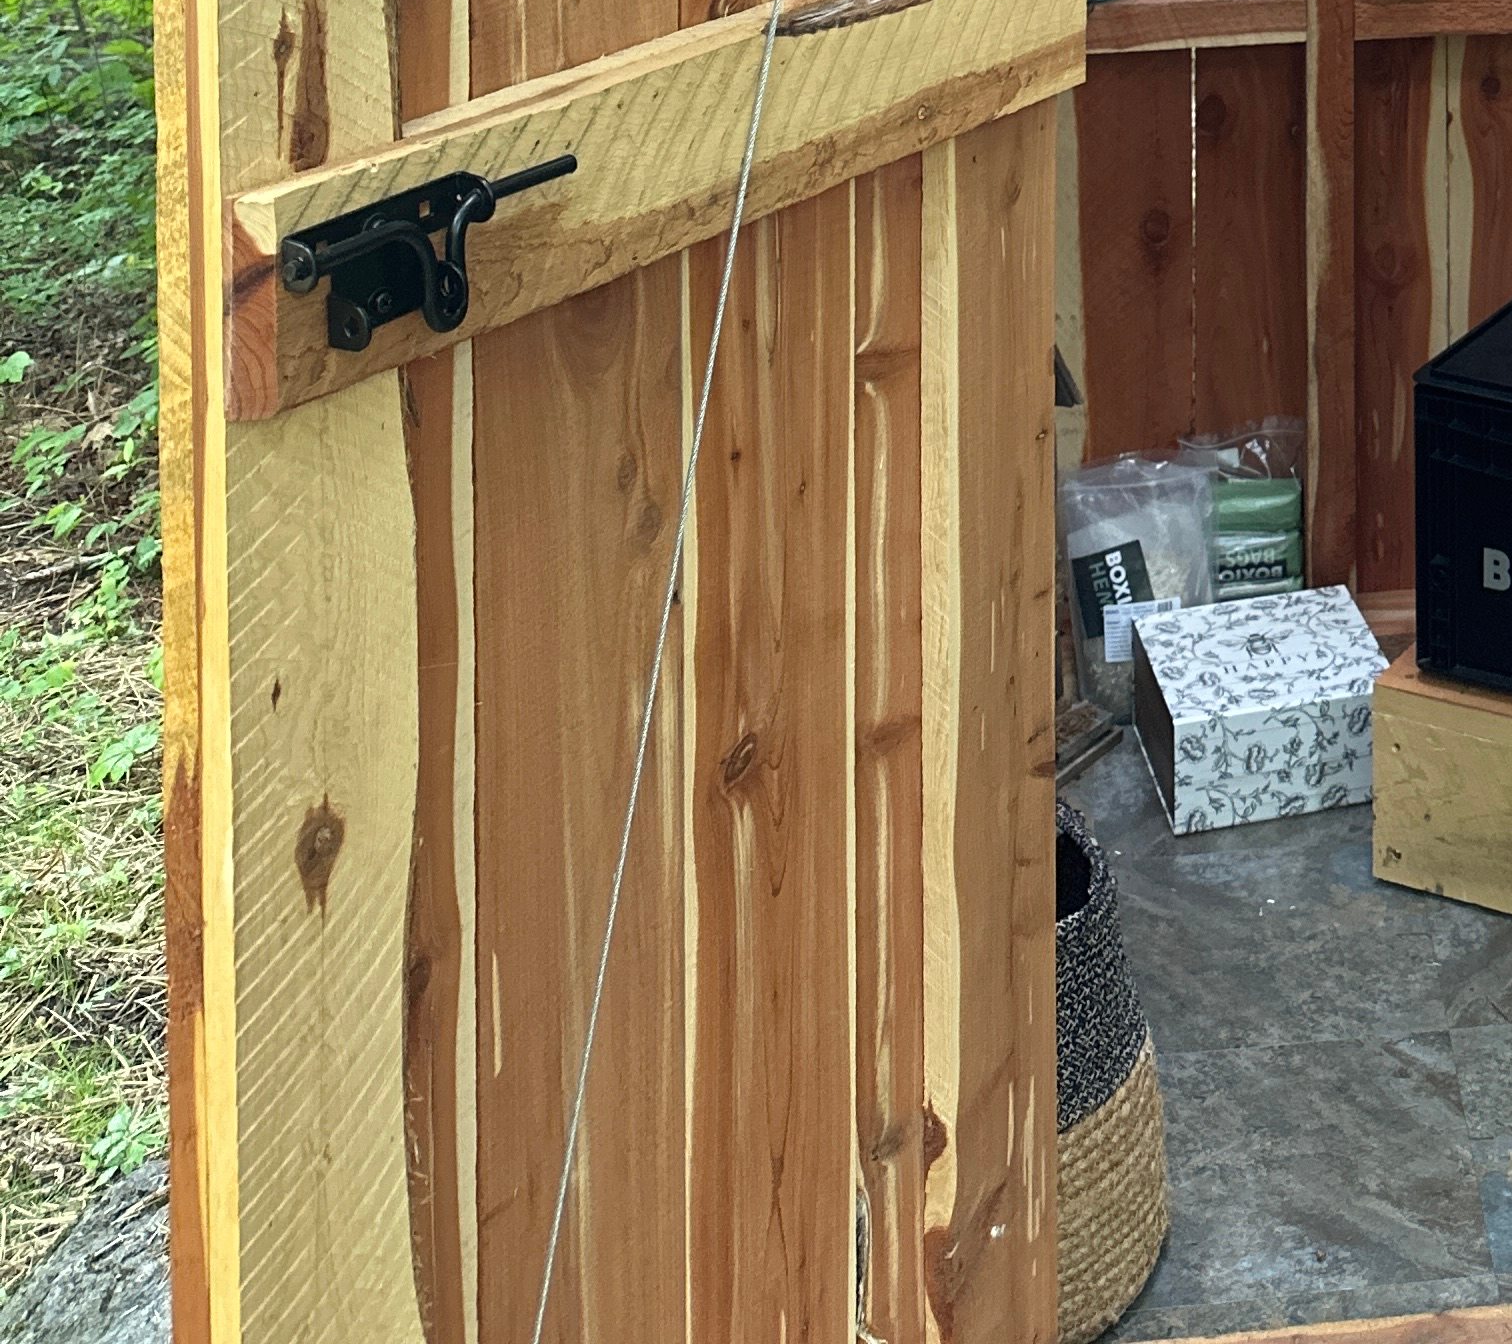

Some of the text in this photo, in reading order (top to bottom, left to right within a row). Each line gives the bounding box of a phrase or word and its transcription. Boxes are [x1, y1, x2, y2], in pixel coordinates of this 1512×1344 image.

[1225, 548, 1275, 568] BAGS
[1105, 550, 1133, 605] BOXI
[1223, 652, 1309, 674] HAPPY
